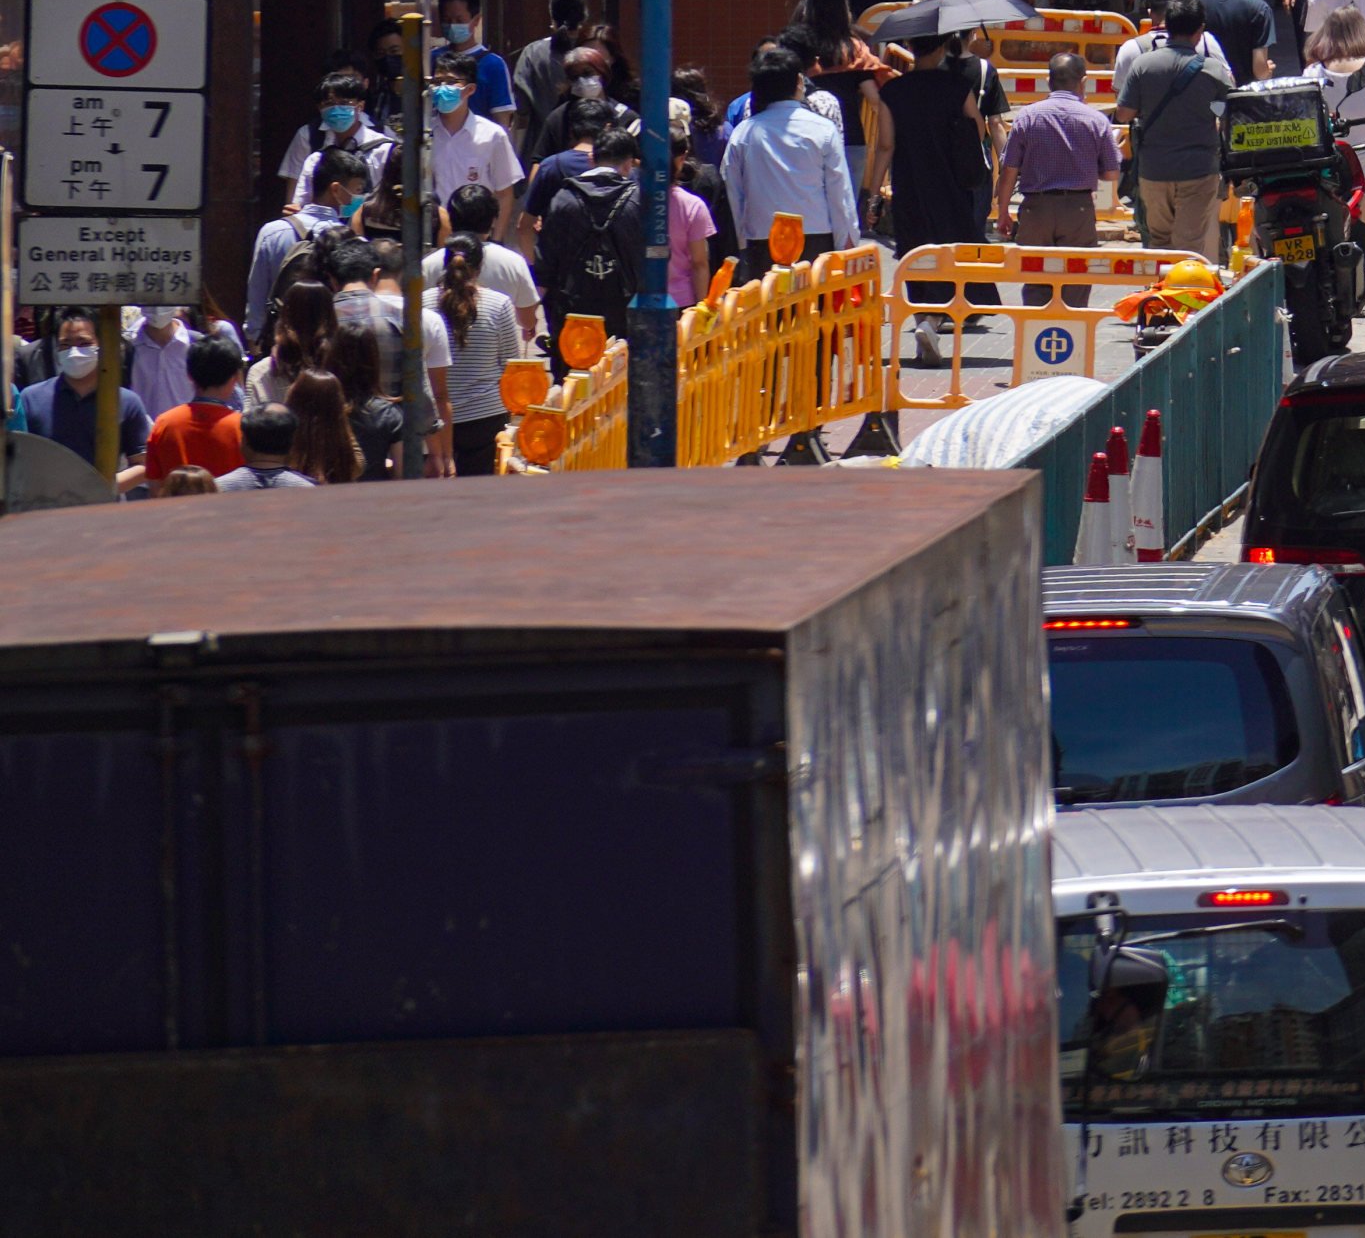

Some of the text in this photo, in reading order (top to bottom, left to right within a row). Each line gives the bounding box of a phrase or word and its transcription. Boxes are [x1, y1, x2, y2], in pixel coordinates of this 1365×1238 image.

[61, 115, 115, 138] 上午
[72, 97, 172, 139] am 7
[1266, 135, 1302, 146] DISTANCE
[60, 179, 112, 201] 下午
[69, 159, 170, 202] pm 7
[78, 226, 146, 244] Except
[1284, 238, 1303, 252] VR
[28, 246, 193, 265] General Holidays
[29, 271, 190, 294] 公眾假期例外
[1121, 1191, 1170, 1209] 2892
[1263, 1185, 1310, 1205] Fax:
[1316, 1184, 1365, 1202] 2831
